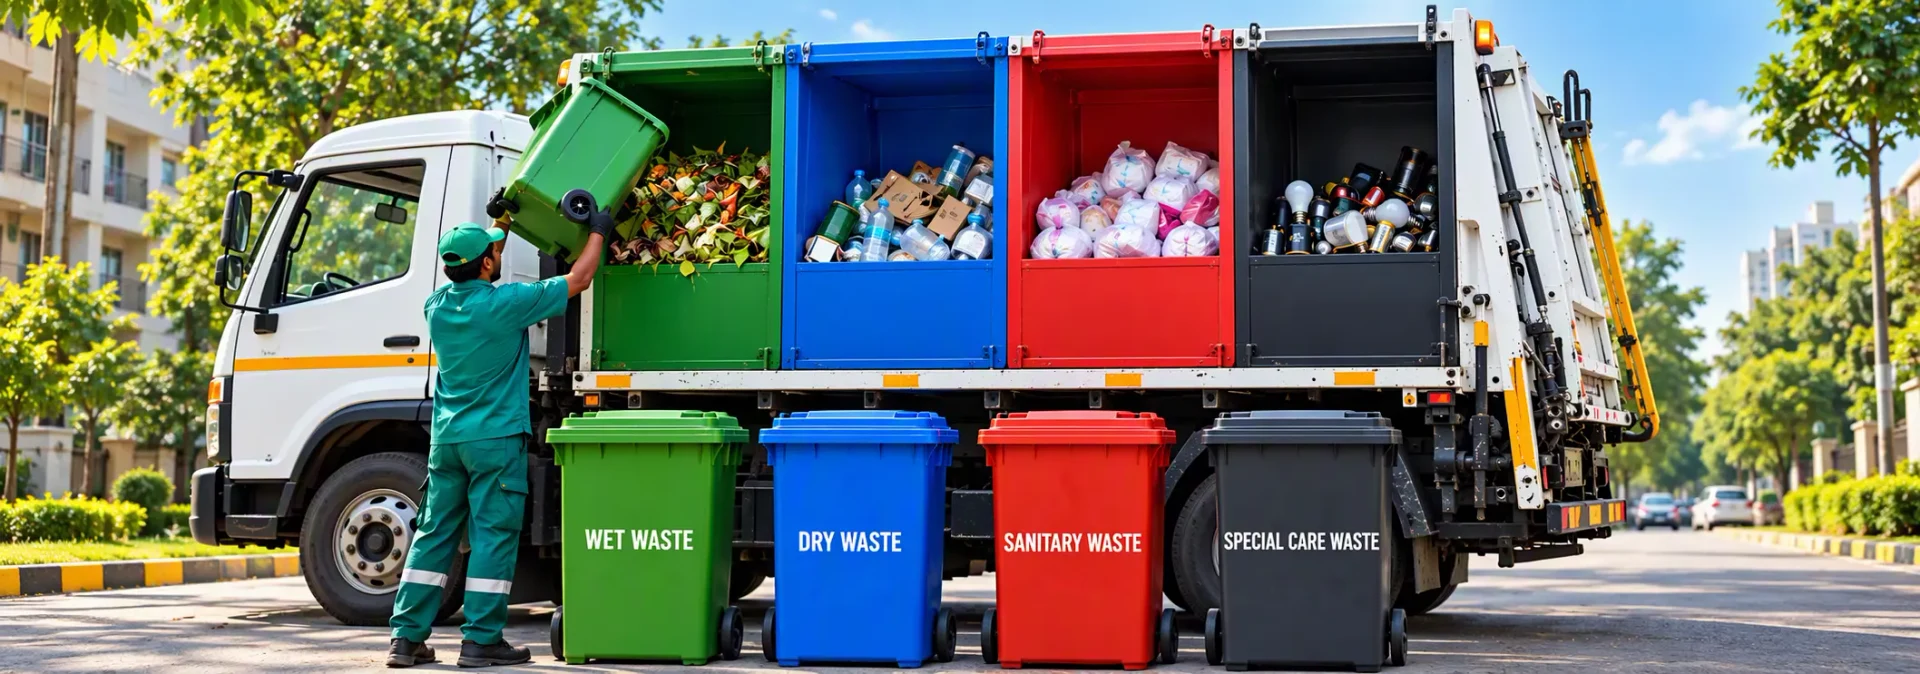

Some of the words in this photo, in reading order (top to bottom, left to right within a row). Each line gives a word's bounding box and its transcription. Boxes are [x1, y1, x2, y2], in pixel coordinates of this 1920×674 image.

[585, 529, 625, 549] WET
[631, 529, 693, 550] WASTE
[799, 531, 834, 551] DRY
[841, 531, 901, 551] WASTE
[1004, 532, 1082, 552] SANITARY
[1087, 532, 1141, 552] WASTE
[1224, 531, 1284, 551] SPECIAL
[1289, 531, 1326, 551] CARE
[1330, 531, 1380, 551] WASTE
